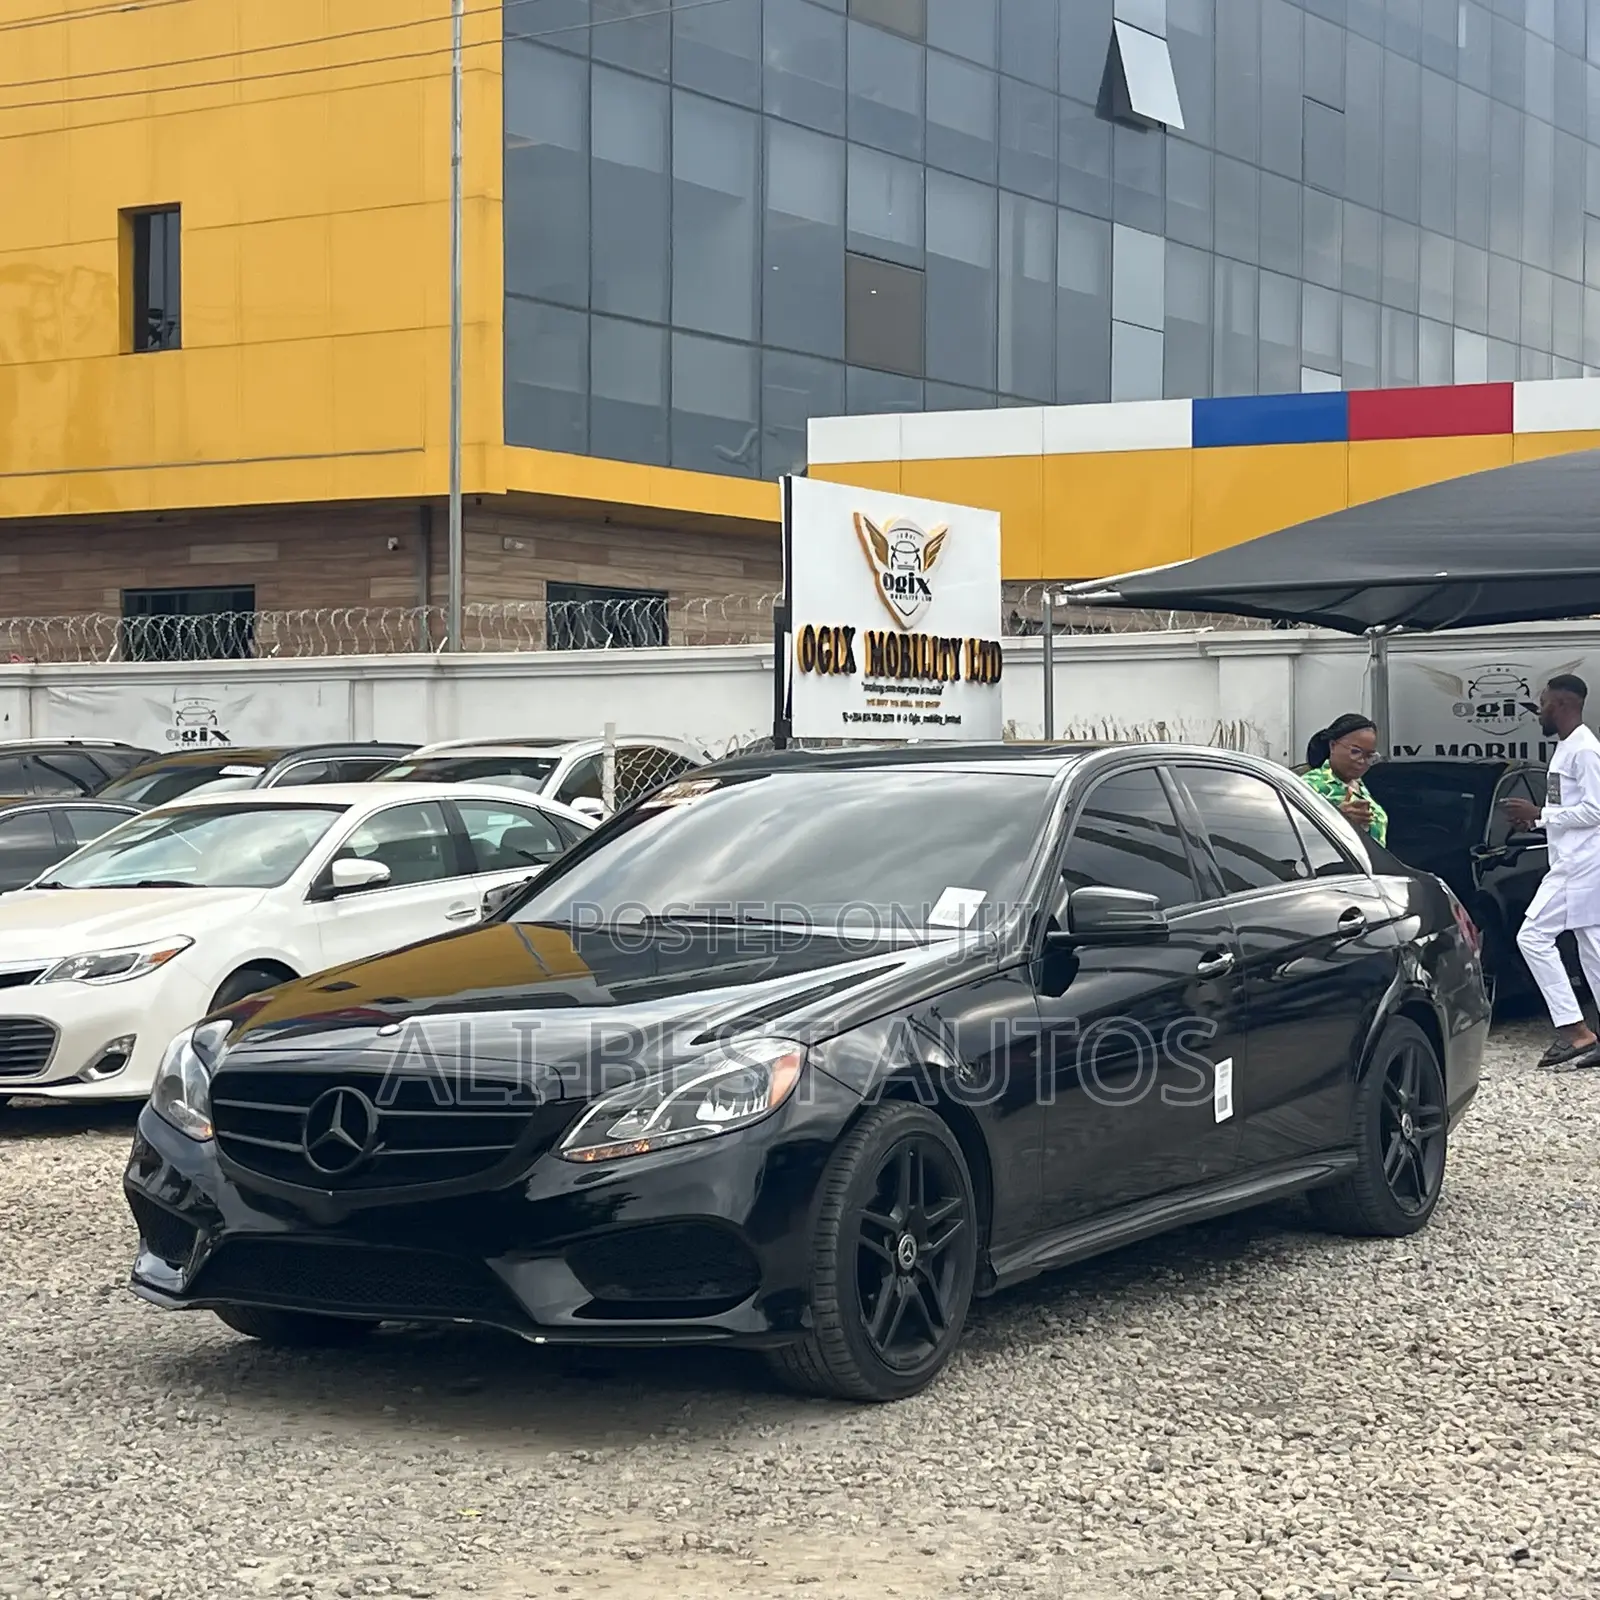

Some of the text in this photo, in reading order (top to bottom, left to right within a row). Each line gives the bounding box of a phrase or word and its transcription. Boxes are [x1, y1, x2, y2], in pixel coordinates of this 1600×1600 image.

[797, 624, 1002, 684] OGIX MOBILITY LTD
